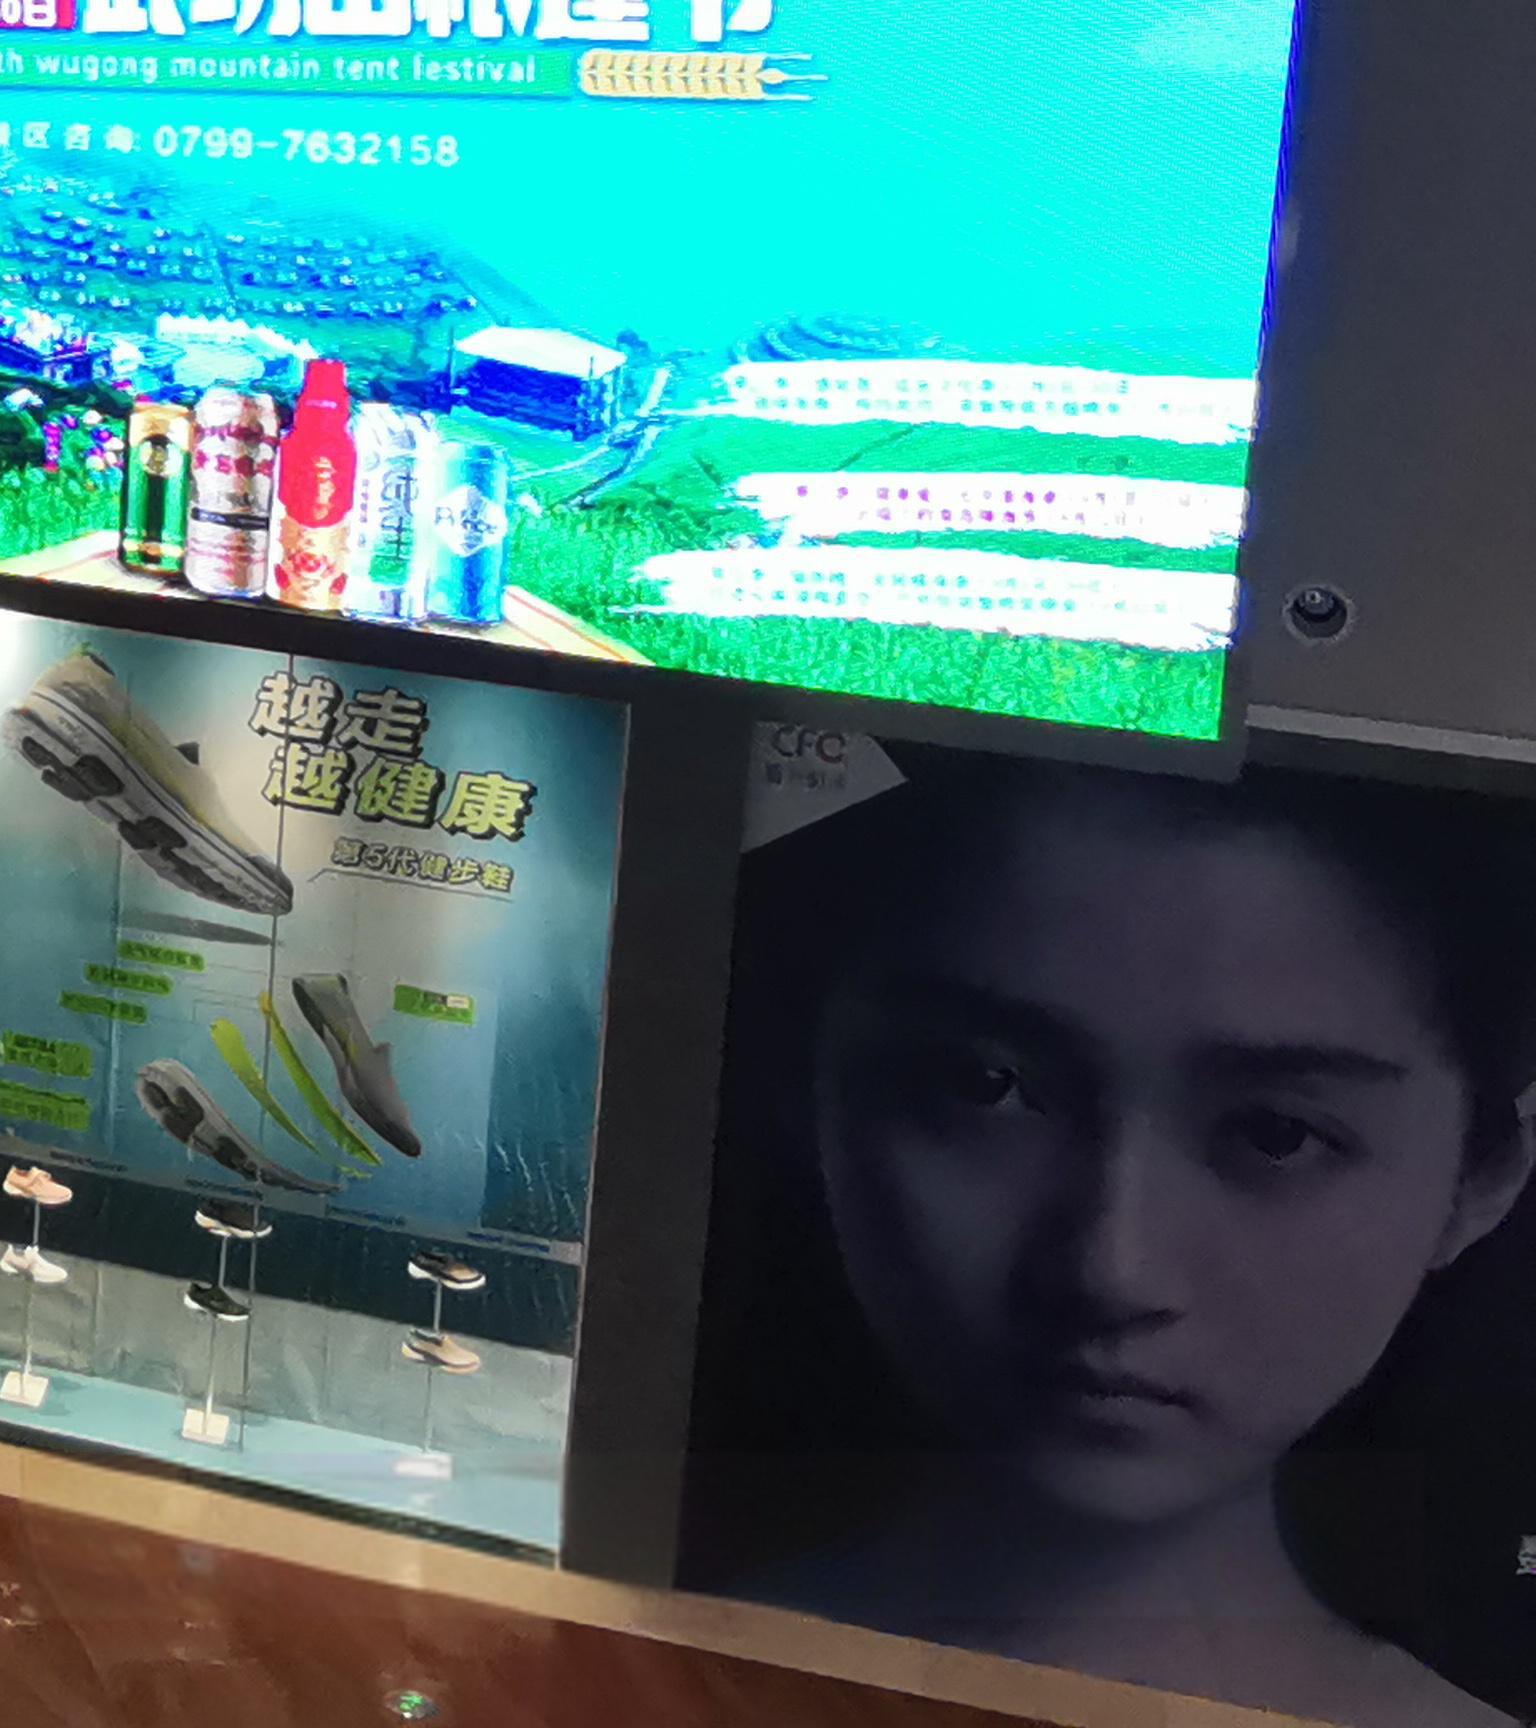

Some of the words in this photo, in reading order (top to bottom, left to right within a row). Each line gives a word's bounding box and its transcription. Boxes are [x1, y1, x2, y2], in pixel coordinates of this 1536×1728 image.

[35, 54, 159, 83] wugong
[170, 51, 319, 81] mountain
[334, 53, 400, 81] tent
[412, 51, 537, 84] festival
[153, 125, 459, 167] 0799-7632158
[248, 670, 429, 757] 越走
[262, 743, 536, 841] 越健康
[332, 835, 514, 894] 第5代健步鞋
